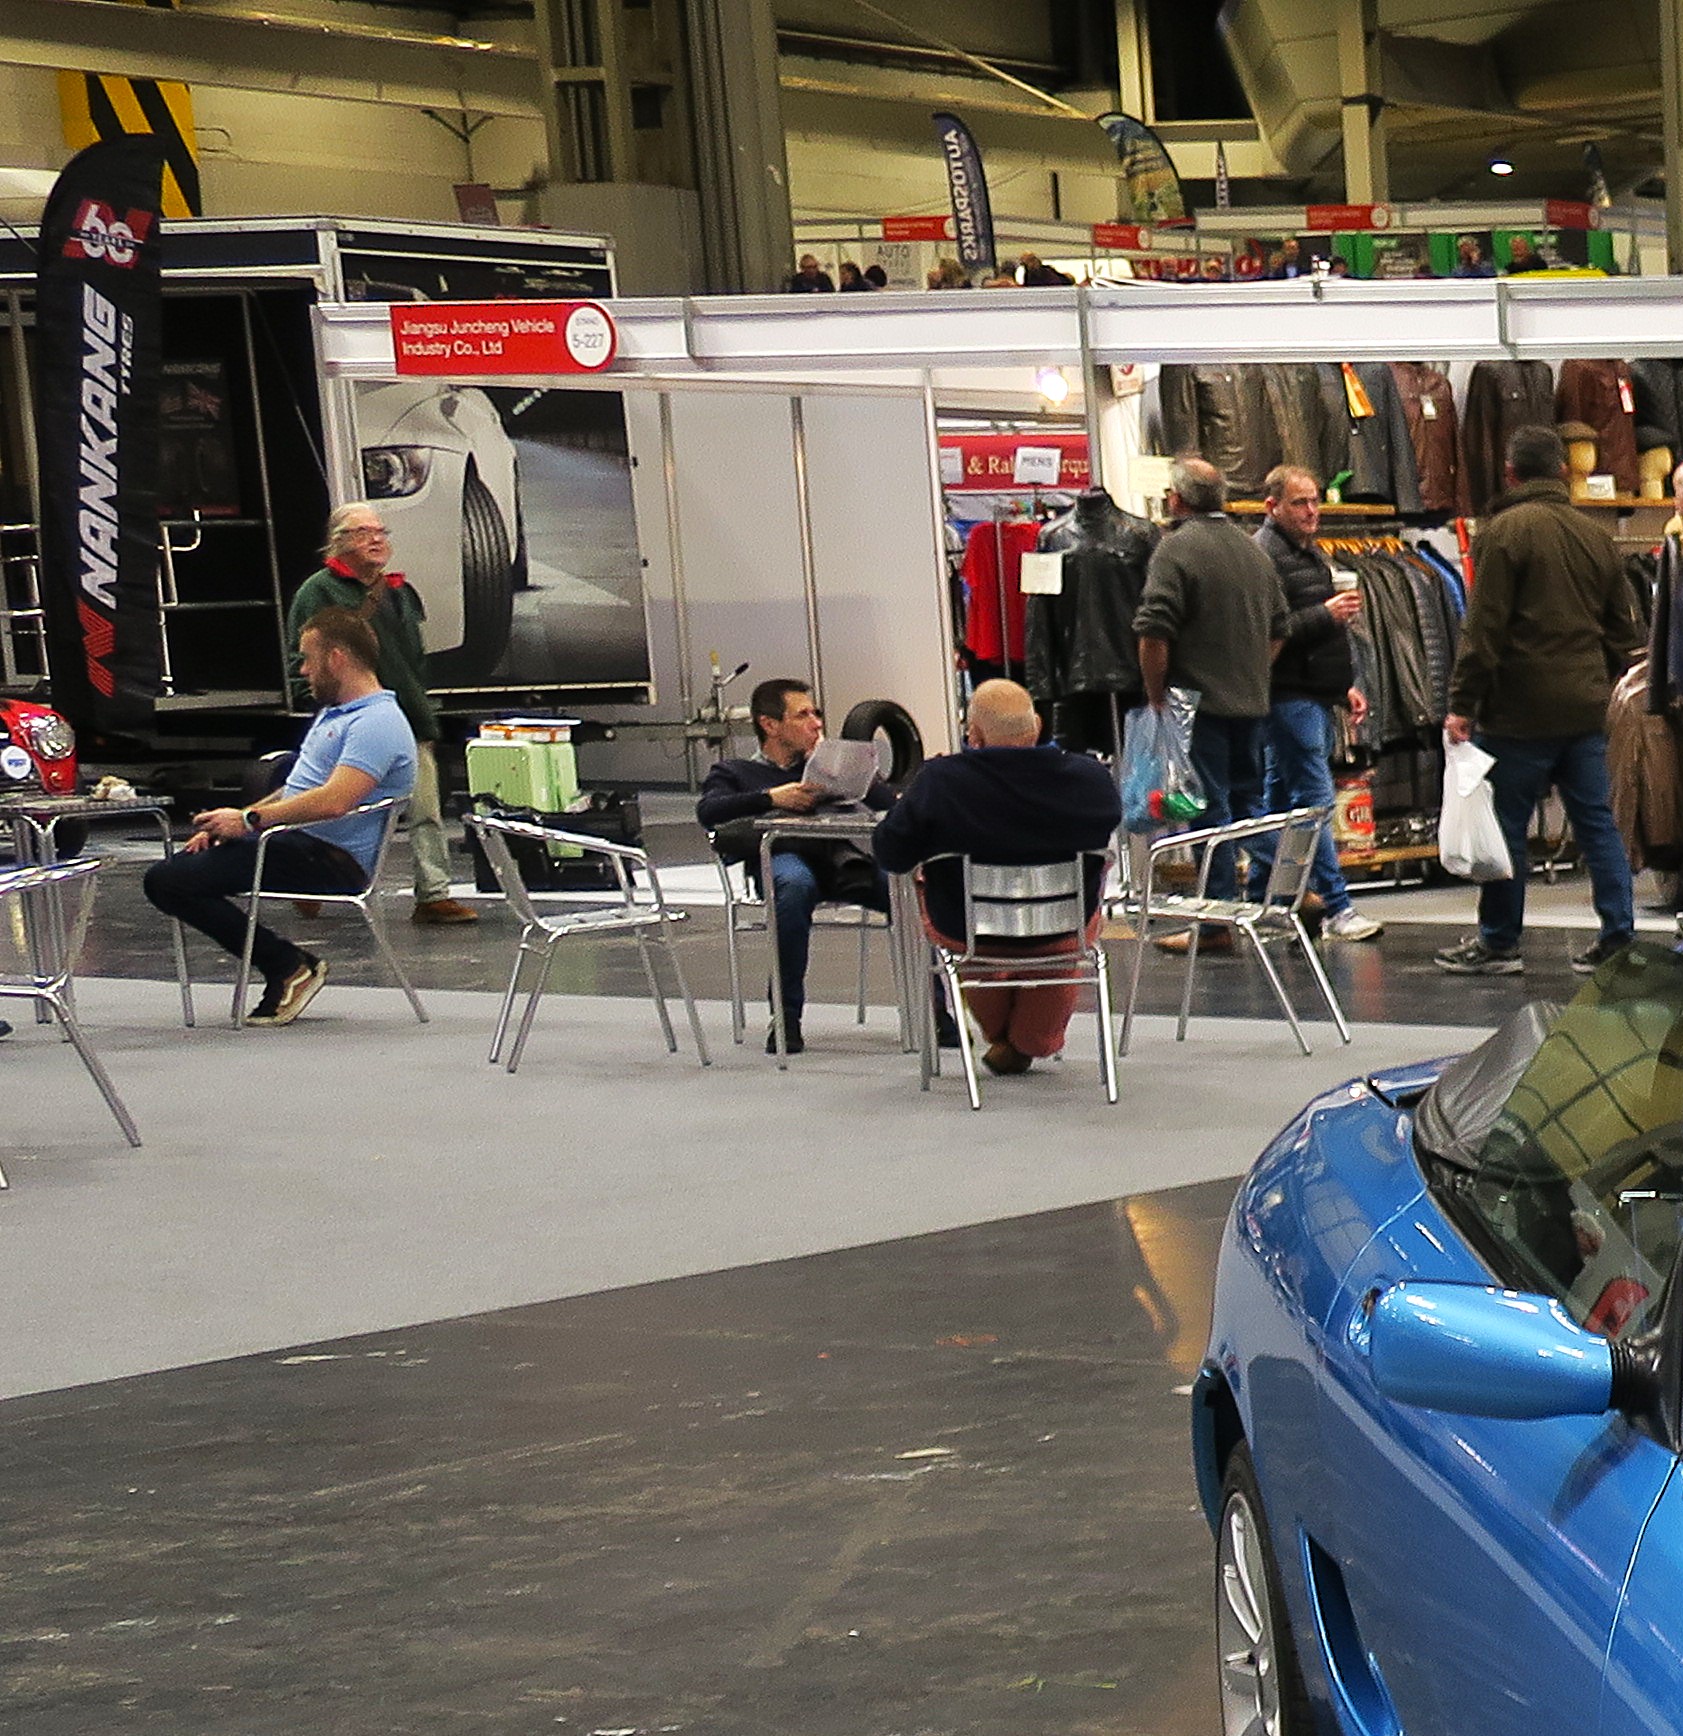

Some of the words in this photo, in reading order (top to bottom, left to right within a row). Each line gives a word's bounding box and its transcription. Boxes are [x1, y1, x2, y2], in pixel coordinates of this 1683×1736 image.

[400, 320, 448, 338] Jiangsu
[449, 319, 510, 337] Juncheng
[510, 318, 555, 334] Vehicle
[402, 341, 450, 358] Industry
[482, 340, 504, 355] Ltd
[572, 333, 605, 350] 5-227
[120, 312, 135, 396] TYRES
[77, 281, 120, 611] NANKANG
[967, 455, 985, 476] &
